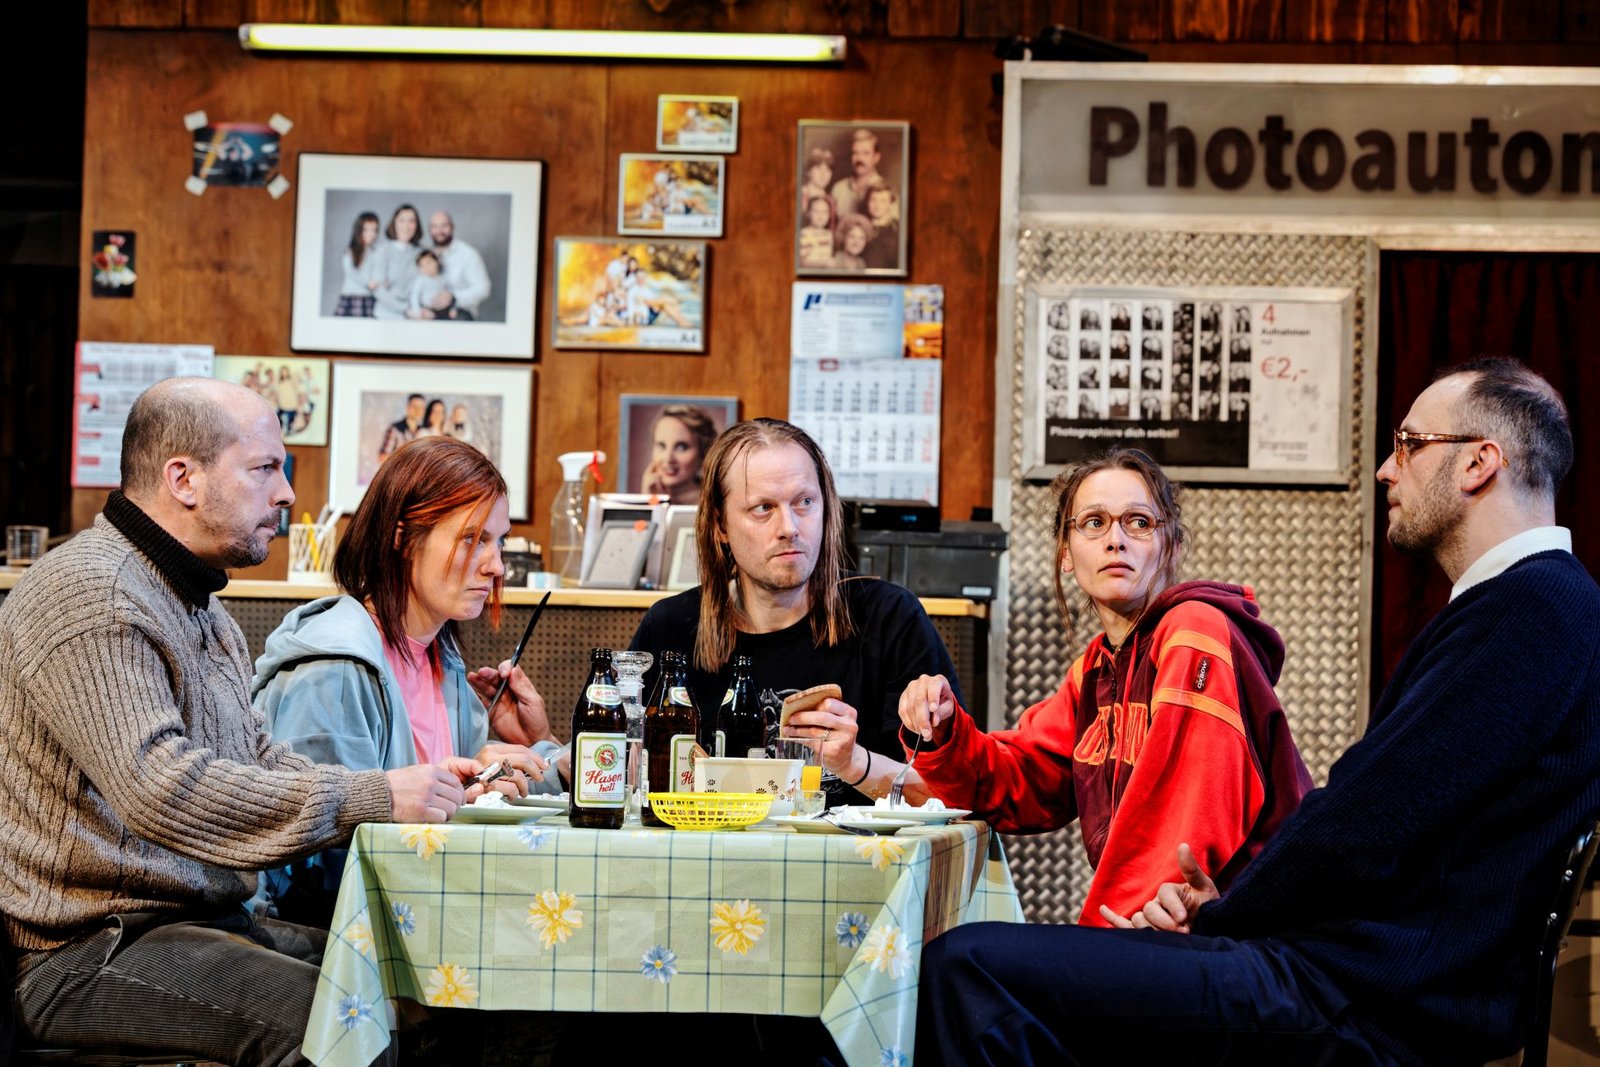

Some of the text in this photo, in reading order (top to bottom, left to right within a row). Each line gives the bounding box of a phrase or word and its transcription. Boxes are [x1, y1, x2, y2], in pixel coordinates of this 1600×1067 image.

[1262, 304, 1275, 325] 4
[1050, 426, 1123, 439] Photographiere
[1124, 428, 1146, 438] dich
[585, 769, 622, 785] Hasen
[599, 783, 615, 793] hell
